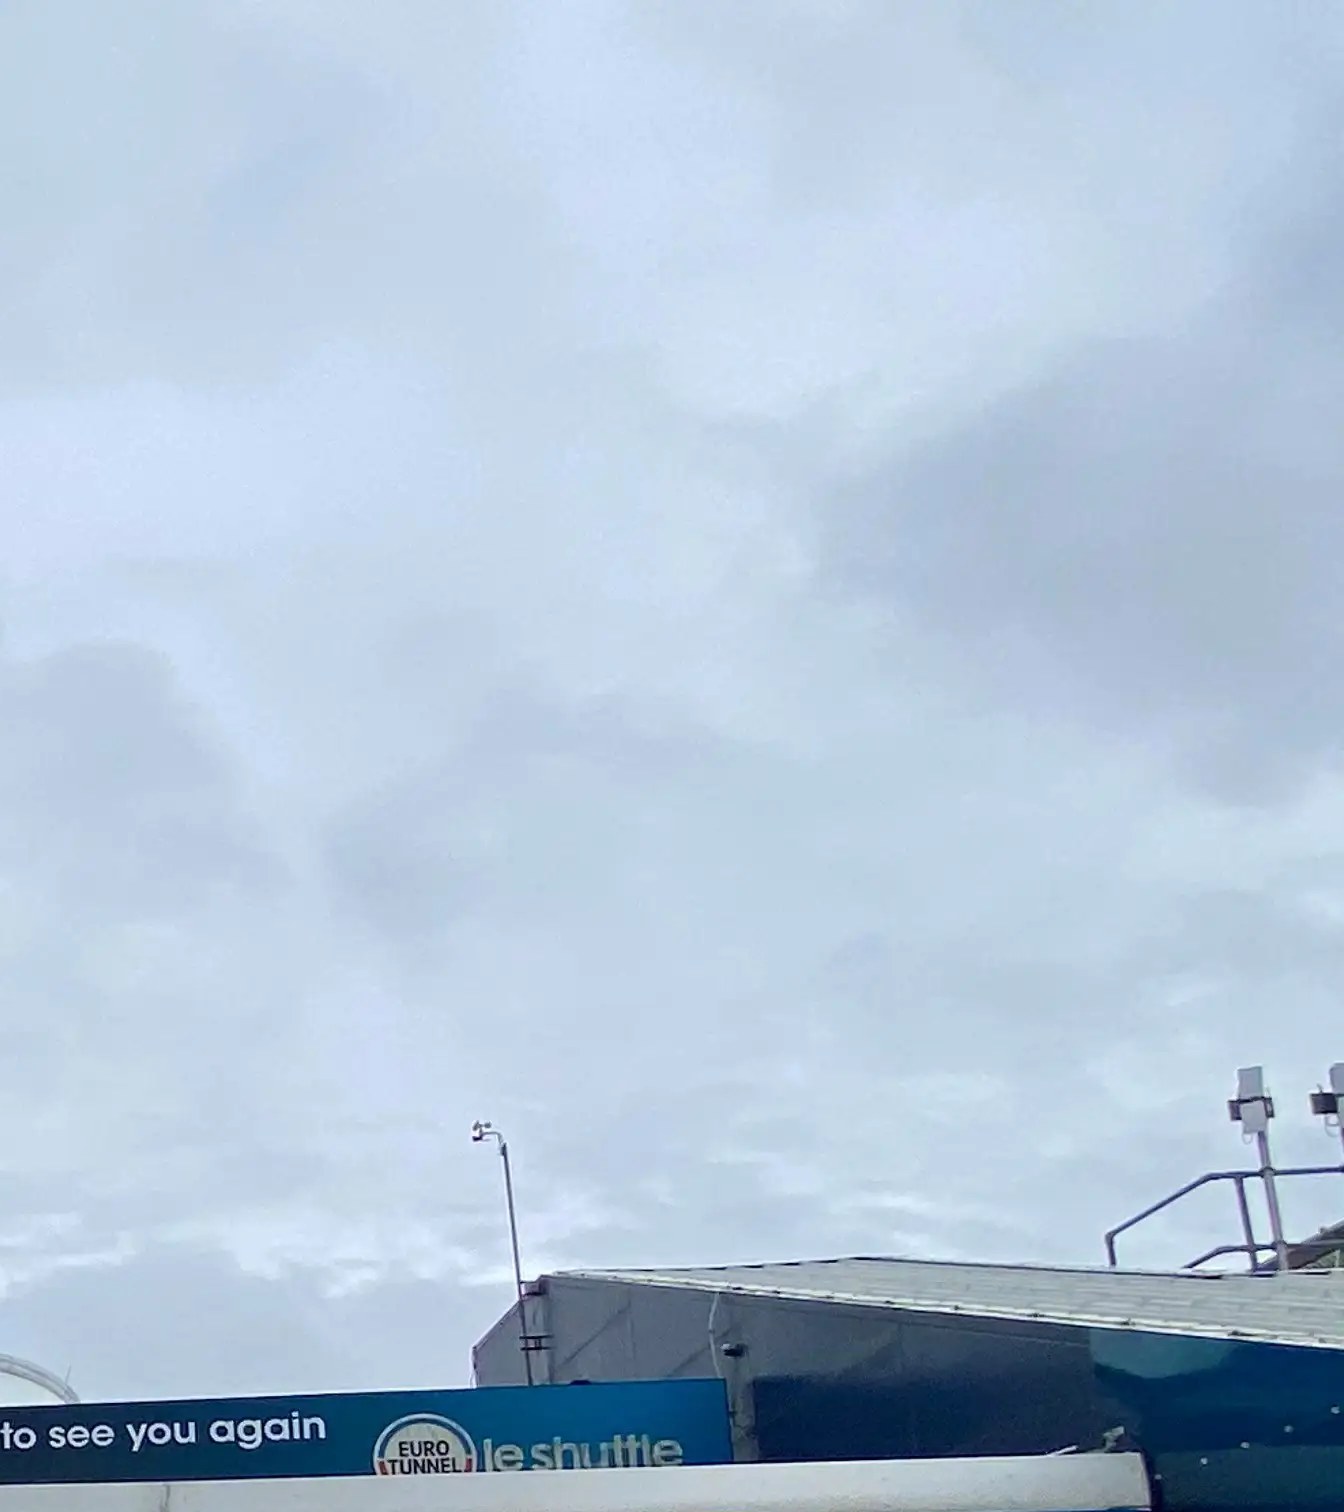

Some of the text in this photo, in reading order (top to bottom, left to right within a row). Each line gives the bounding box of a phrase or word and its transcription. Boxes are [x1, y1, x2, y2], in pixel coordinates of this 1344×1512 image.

[0, 1420, 37, 1452] to
[48, 1421, 115, 1449] see
[127, 1420, 197, 1453] you
[208, 1411, 327, 1451] again
[398, 1440, 450, 1458] EURO
[387, 1457, 463, 1476] TUNNEL
